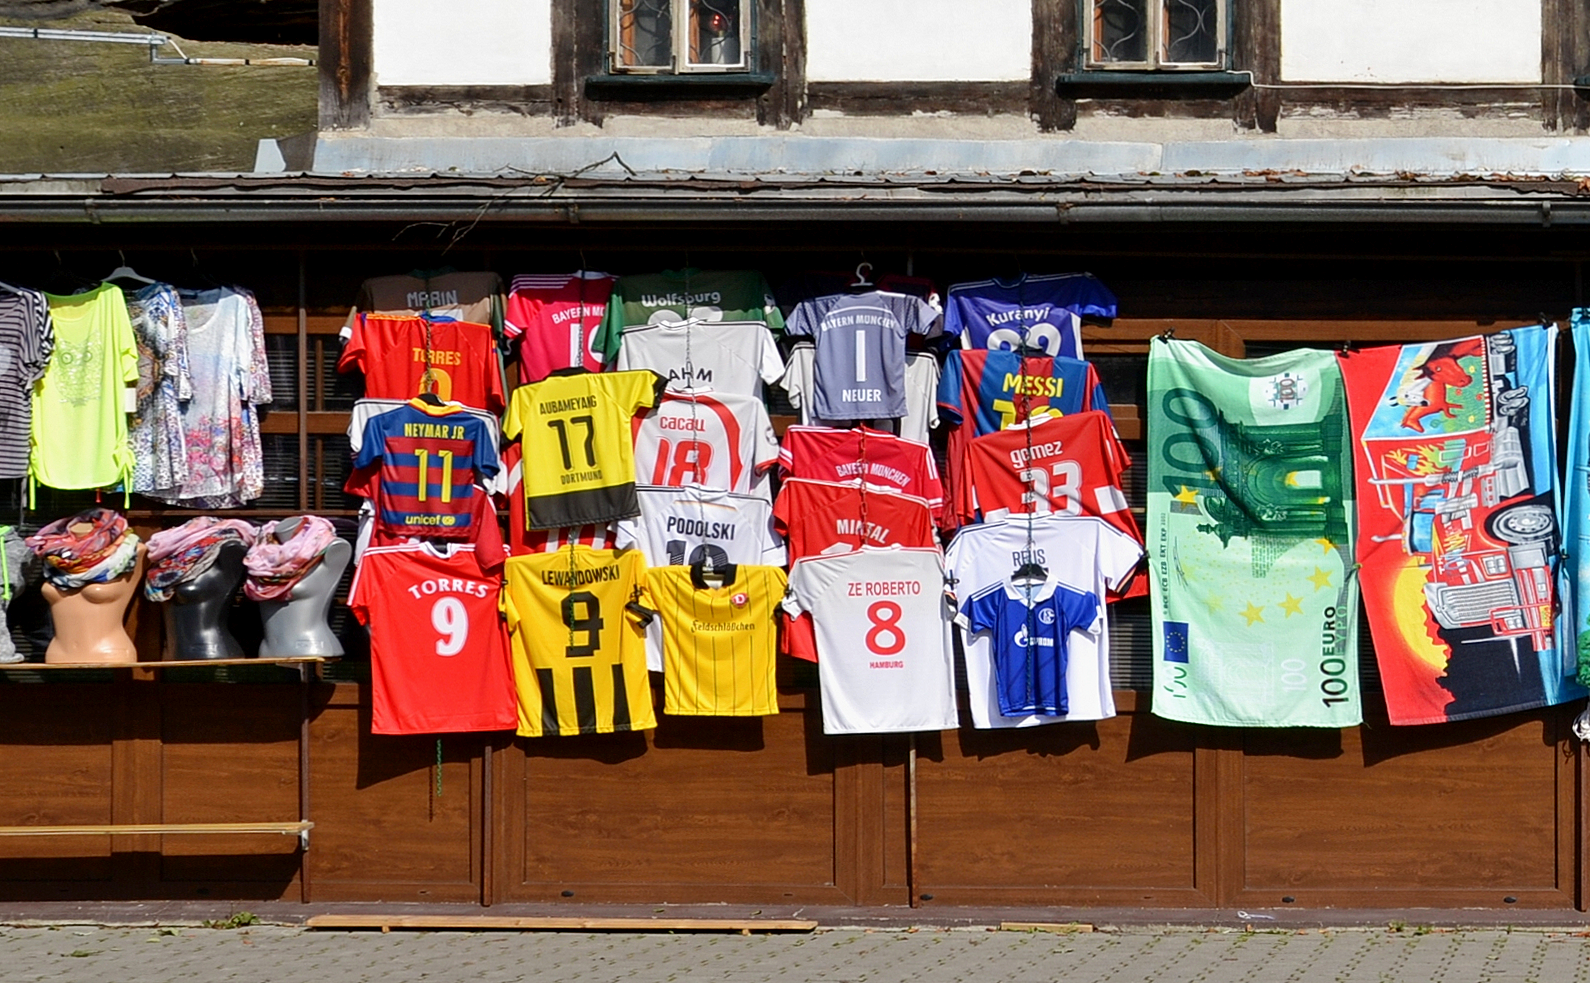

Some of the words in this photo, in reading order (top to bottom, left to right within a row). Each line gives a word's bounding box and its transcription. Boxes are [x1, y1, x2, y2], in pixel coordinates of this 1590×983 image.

[641, 292, 722, 308] Wolfsburg
[820, 316, 854, 332] BAYERN
[985, 307, 1051, 327] Kuranyi
[842, 388, 882, 402] NEUER
[1002, 372, 1064, 398] MESSI
[539, 395, 598, 415] AUBAMEYANG
[403, 422, 450, 439] NEYMAR
[450, 425, 465, 440] JR
[547, 414, 598, 471] 17
[1162, 387, 1221, 499] 100
[651, 436, 714, 487] 18
[413, 448, 454, 503] 11
[560, 470, 603, 486] DORTMUND
[1016, 459, 1082, 517] 33
[404, 514, 441, 526] unicef
[666, 515, 736, 541] PODOLSKI
[541, 564, 620, 586] LEWANDOWSKI
[407, 578, 489, 599] TORRES
[847, 582, 863, 597] ZE
[865, 580, 921, 596] ROBERTO
[430, 596, 469, 657] 9
[561, 591, 604, 657] 9
[691, 619, 755, 633] Feldschlößchen
[865, 599, 906, 656] 8
[1322, 606, 1336, 657] EURO
[869, 660, 904, 669] HAMBURG
[1319, 658, 1350, 709] 100
